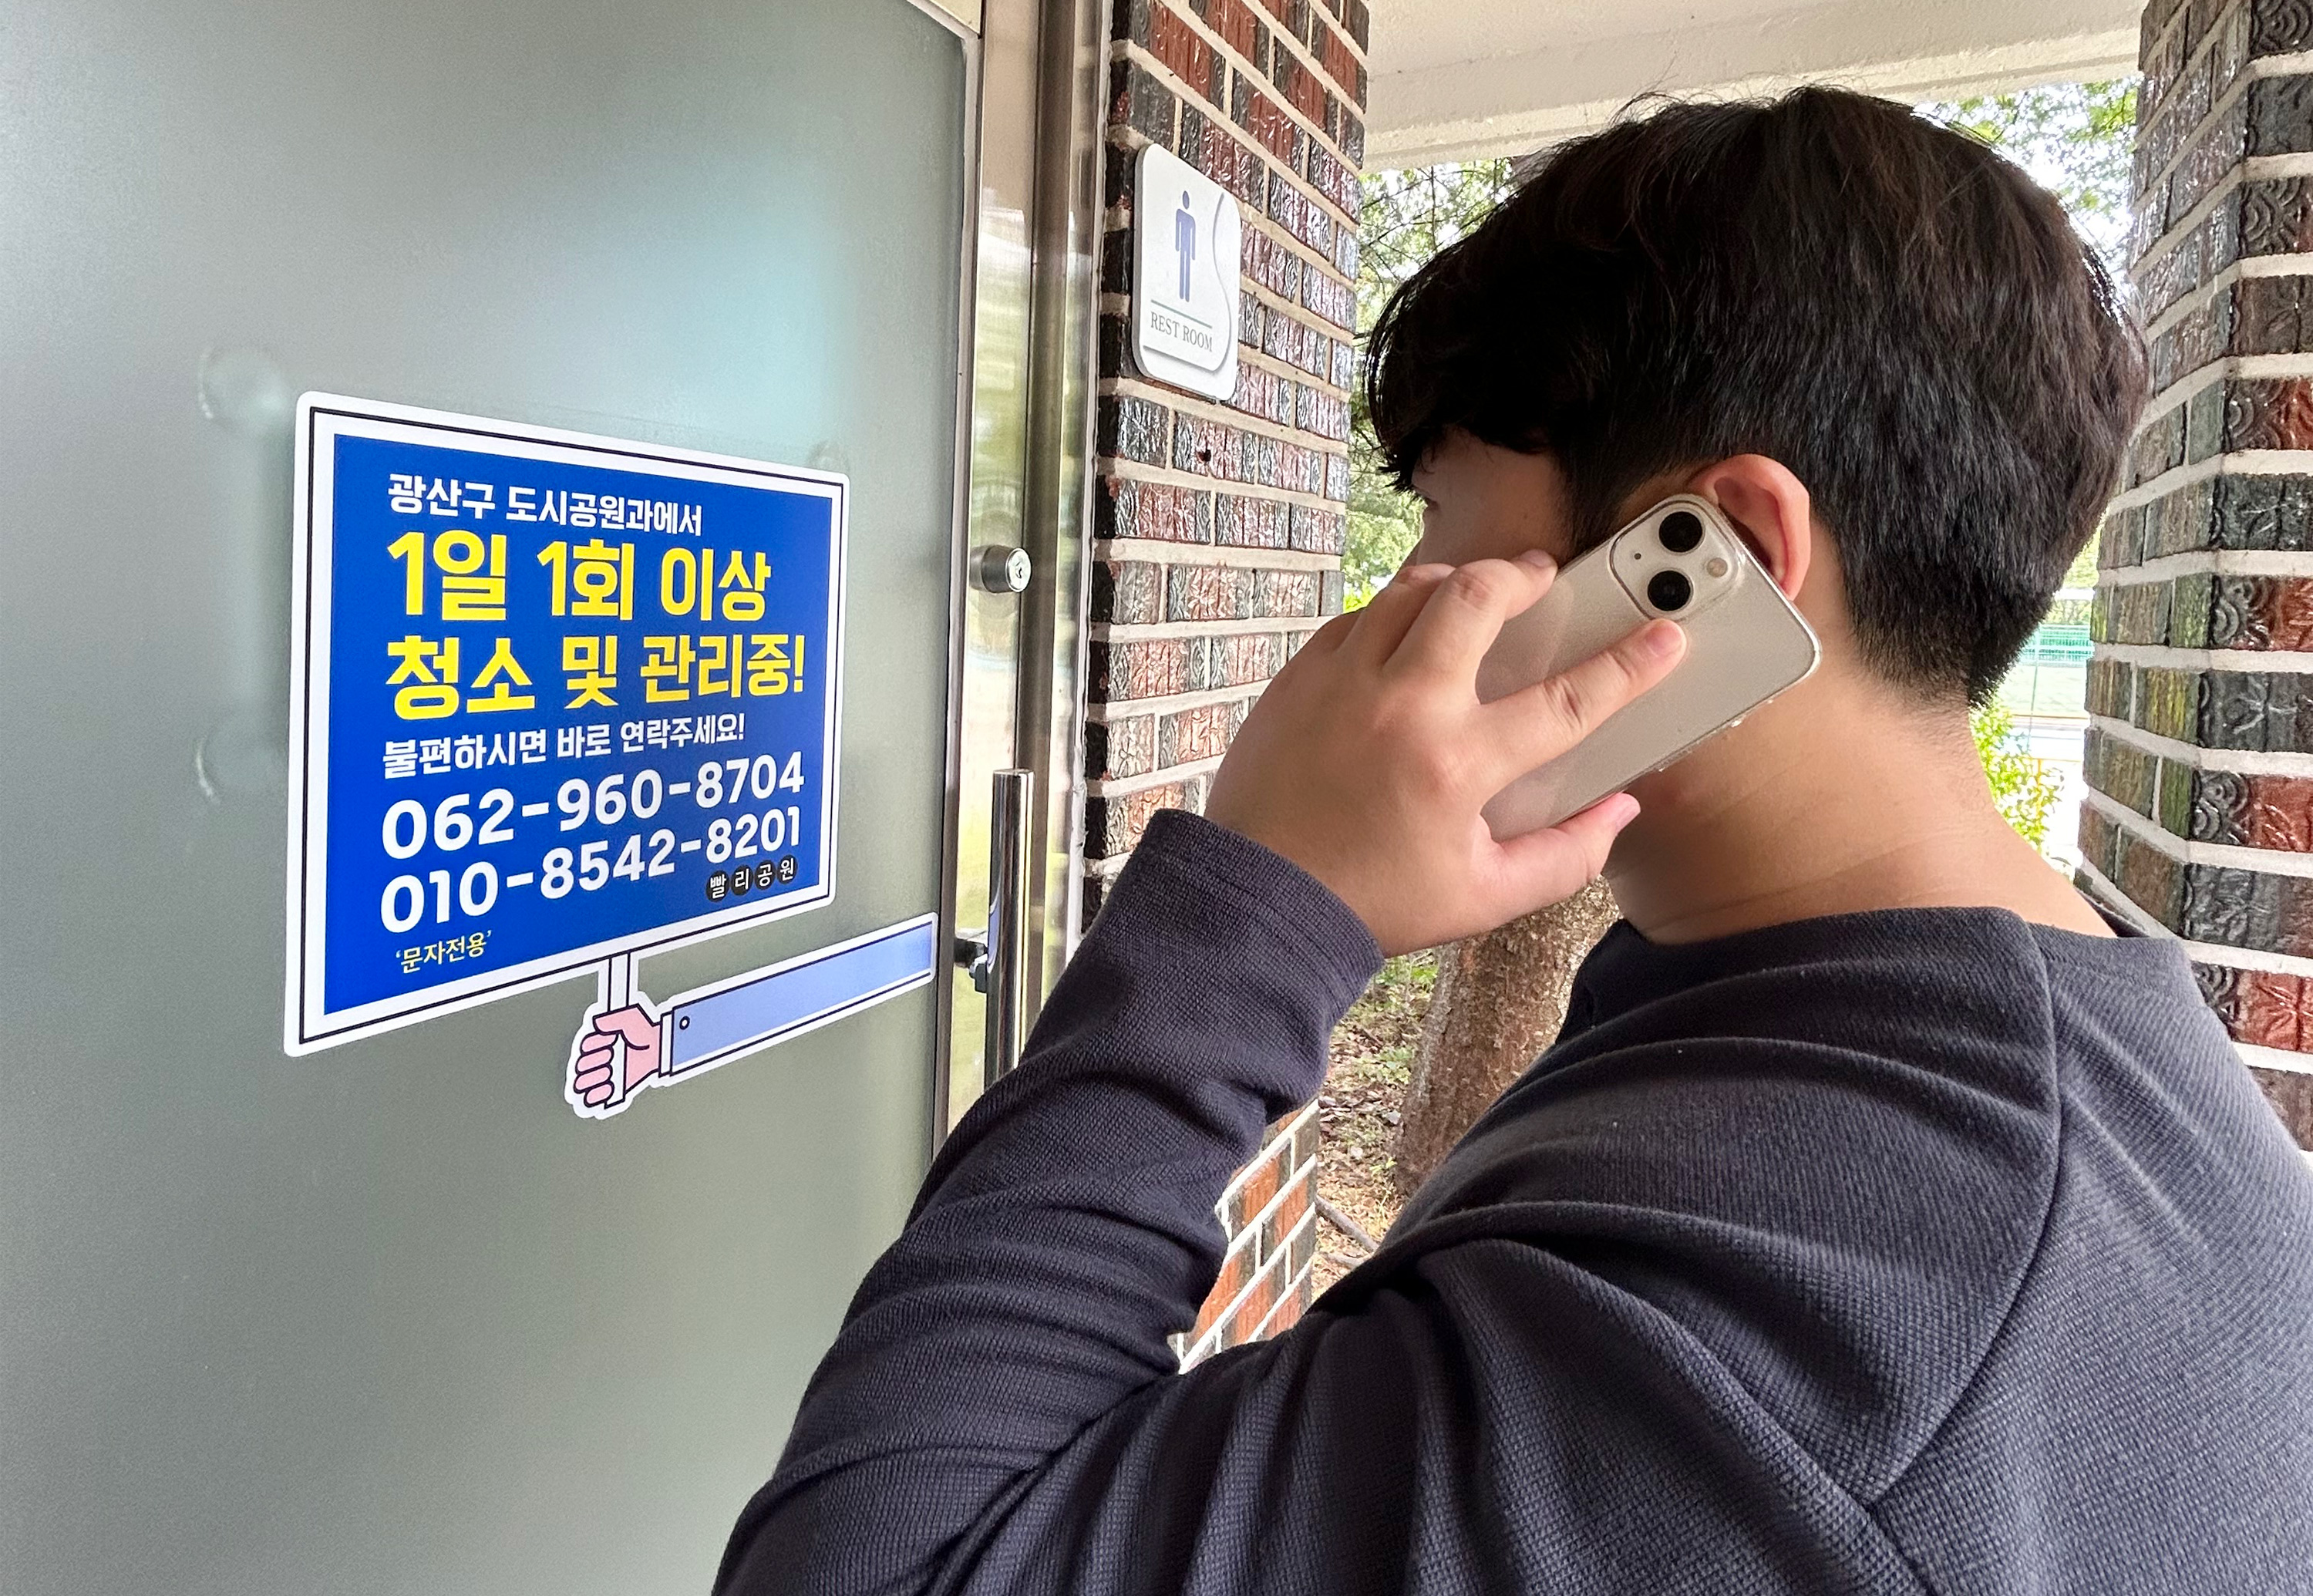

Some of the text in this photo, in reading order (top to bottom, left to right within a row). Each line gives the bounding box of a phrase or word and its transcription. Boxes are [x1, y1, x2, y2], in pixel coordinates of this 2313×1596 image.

[1150, 311, 1212, 352] REST ROOM
[388, 473, 702, 537] 광산구 도시공원과에서
[387, 529, 772, 621] 1일 1회 이상
[386, 634, 806, 721] 청소 및 관리중!
[382, 712, 746, 780] 불편하시면 바로 연락주세요!
[380, 751, 805, 860] 062-960-8704
[379, 806, 801, 934] 010-8542-8201
